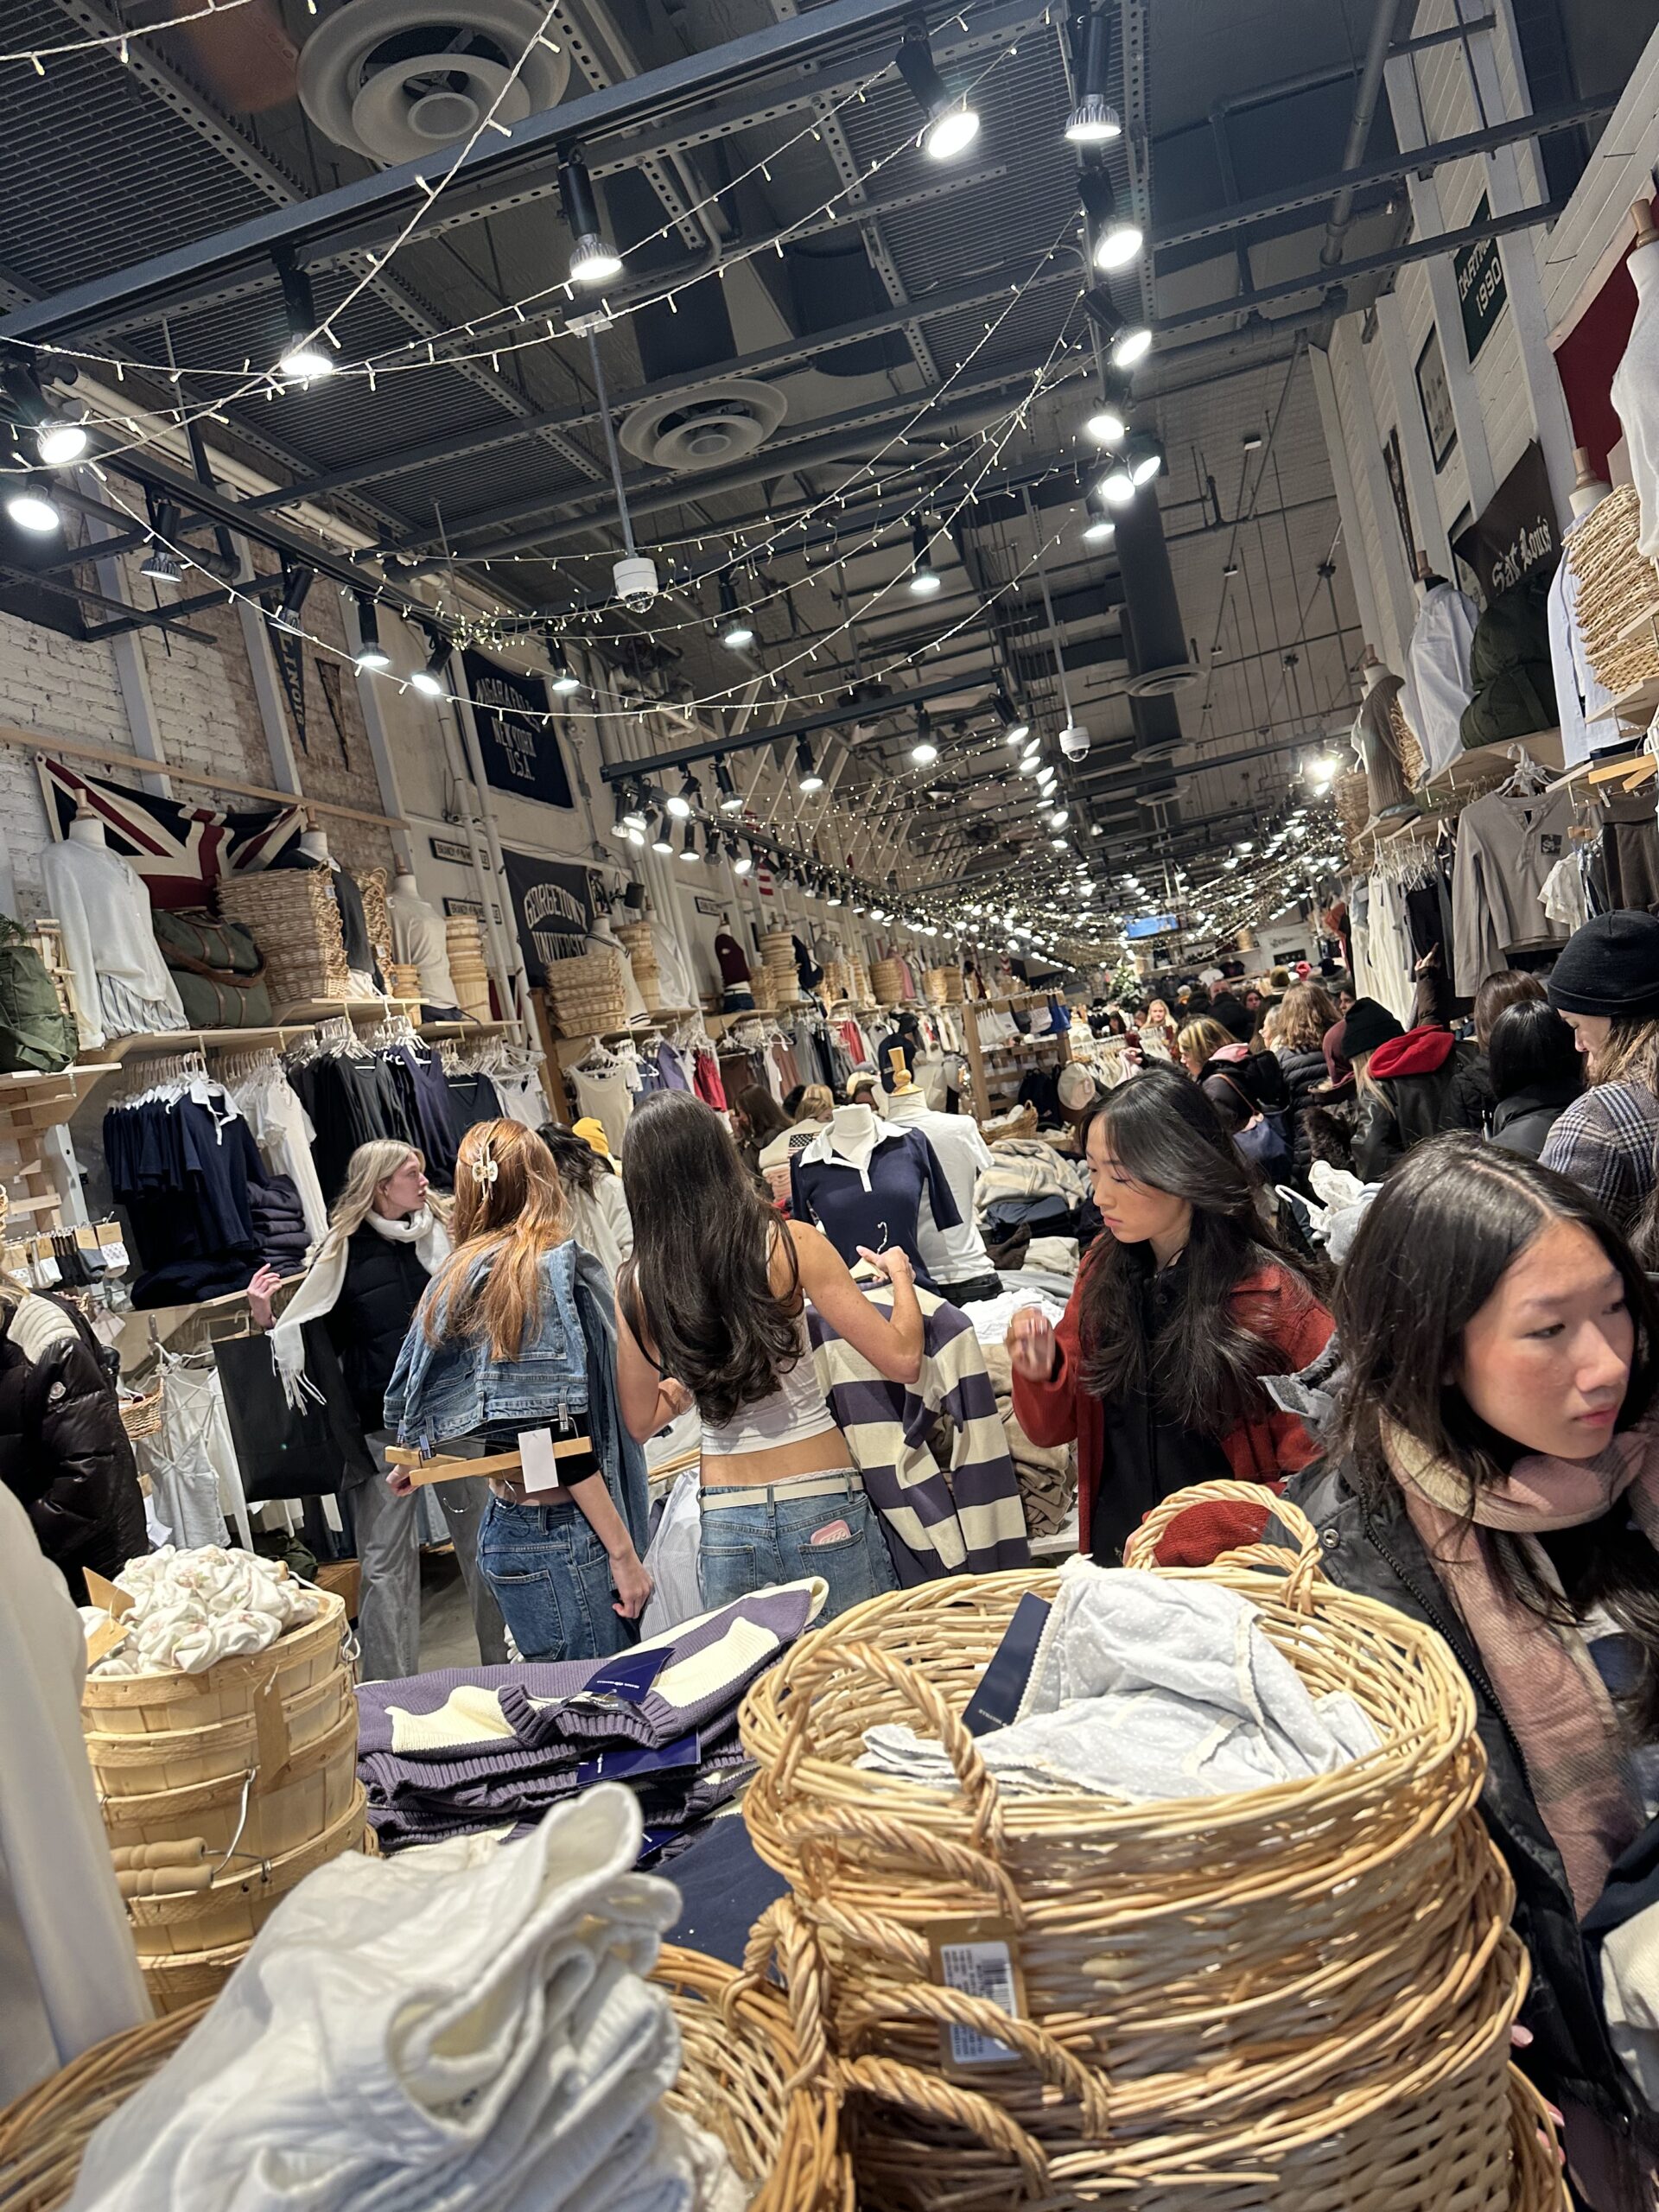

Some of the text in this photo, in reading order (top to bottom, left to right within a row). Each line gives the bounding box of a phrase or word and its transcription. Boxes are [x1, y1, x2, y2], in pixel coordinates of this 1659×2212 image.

[1459, 235, 1491, 302] DARTM
[1476, 257, 1502, 316] 1990
[276, 626, 305, 725] LINOIS
[505, 747, 535, 781] USA
[524, 883, 588, 933] GEORGETOWN
[531, 931, 588, 963] UNIVERSIT
